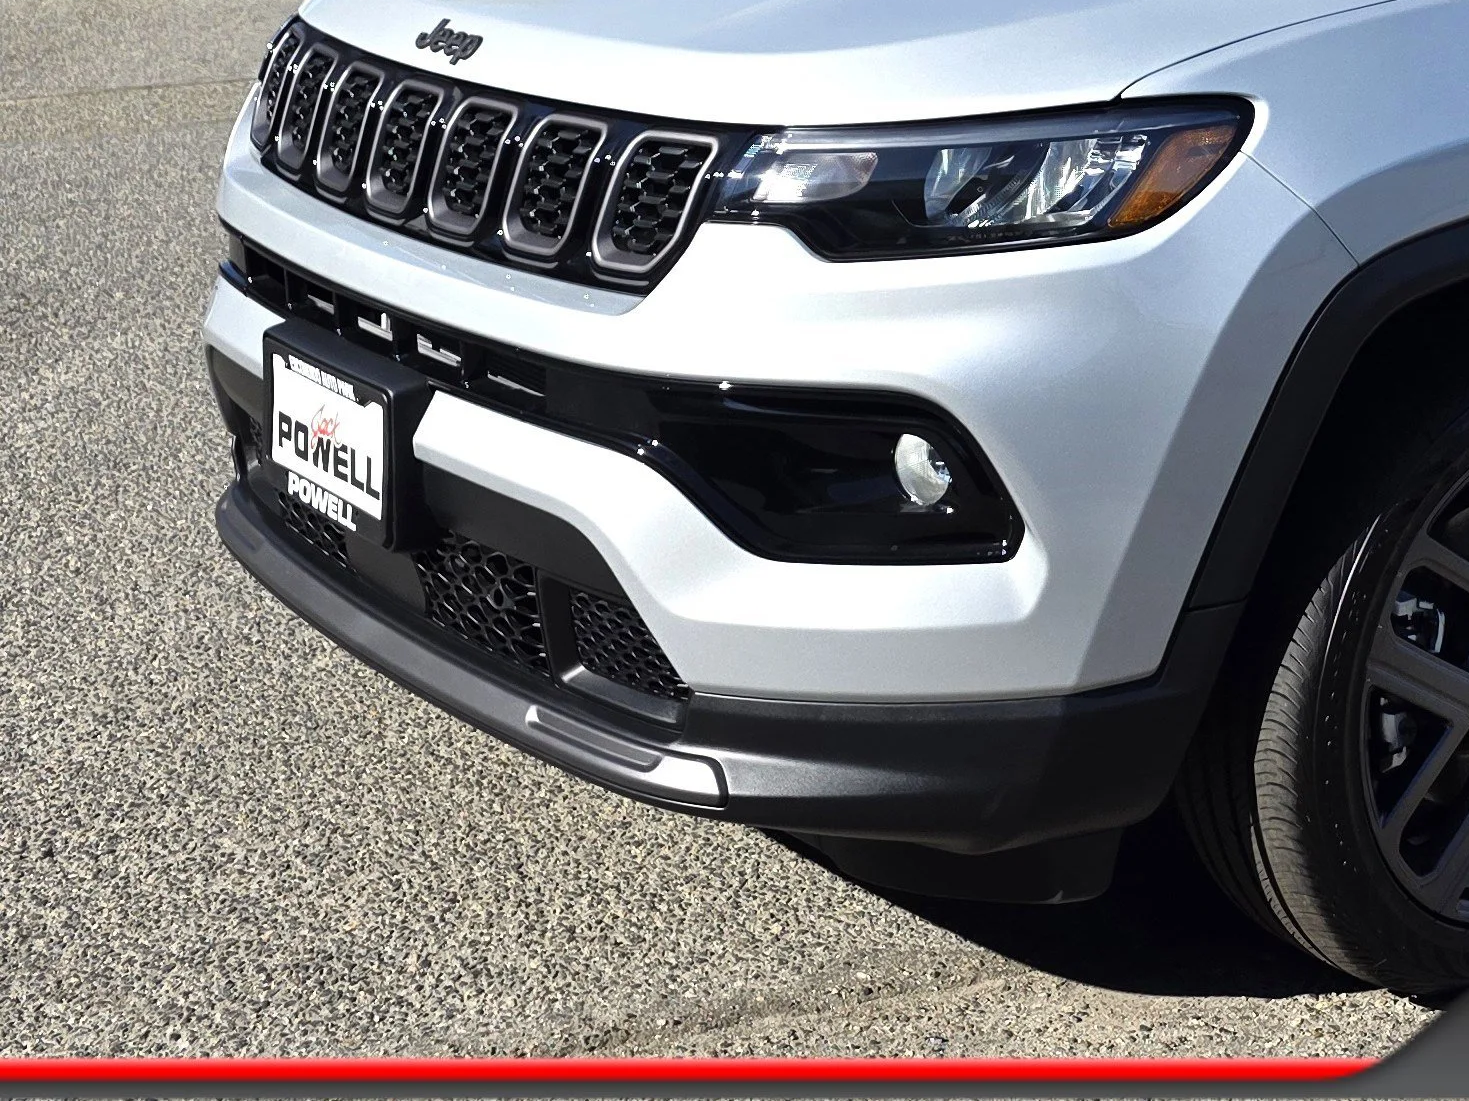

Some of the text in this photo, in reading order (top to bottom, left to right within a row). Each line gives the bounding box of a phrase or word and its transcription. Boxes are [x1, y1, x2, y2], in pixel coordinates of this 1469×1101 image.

[415, 18, 484, 66] Jeep
[310, 403, 343, 449] Jack
[278, 410, 380, 501] POWELL
[287, 471, 357, 532] POWELL
